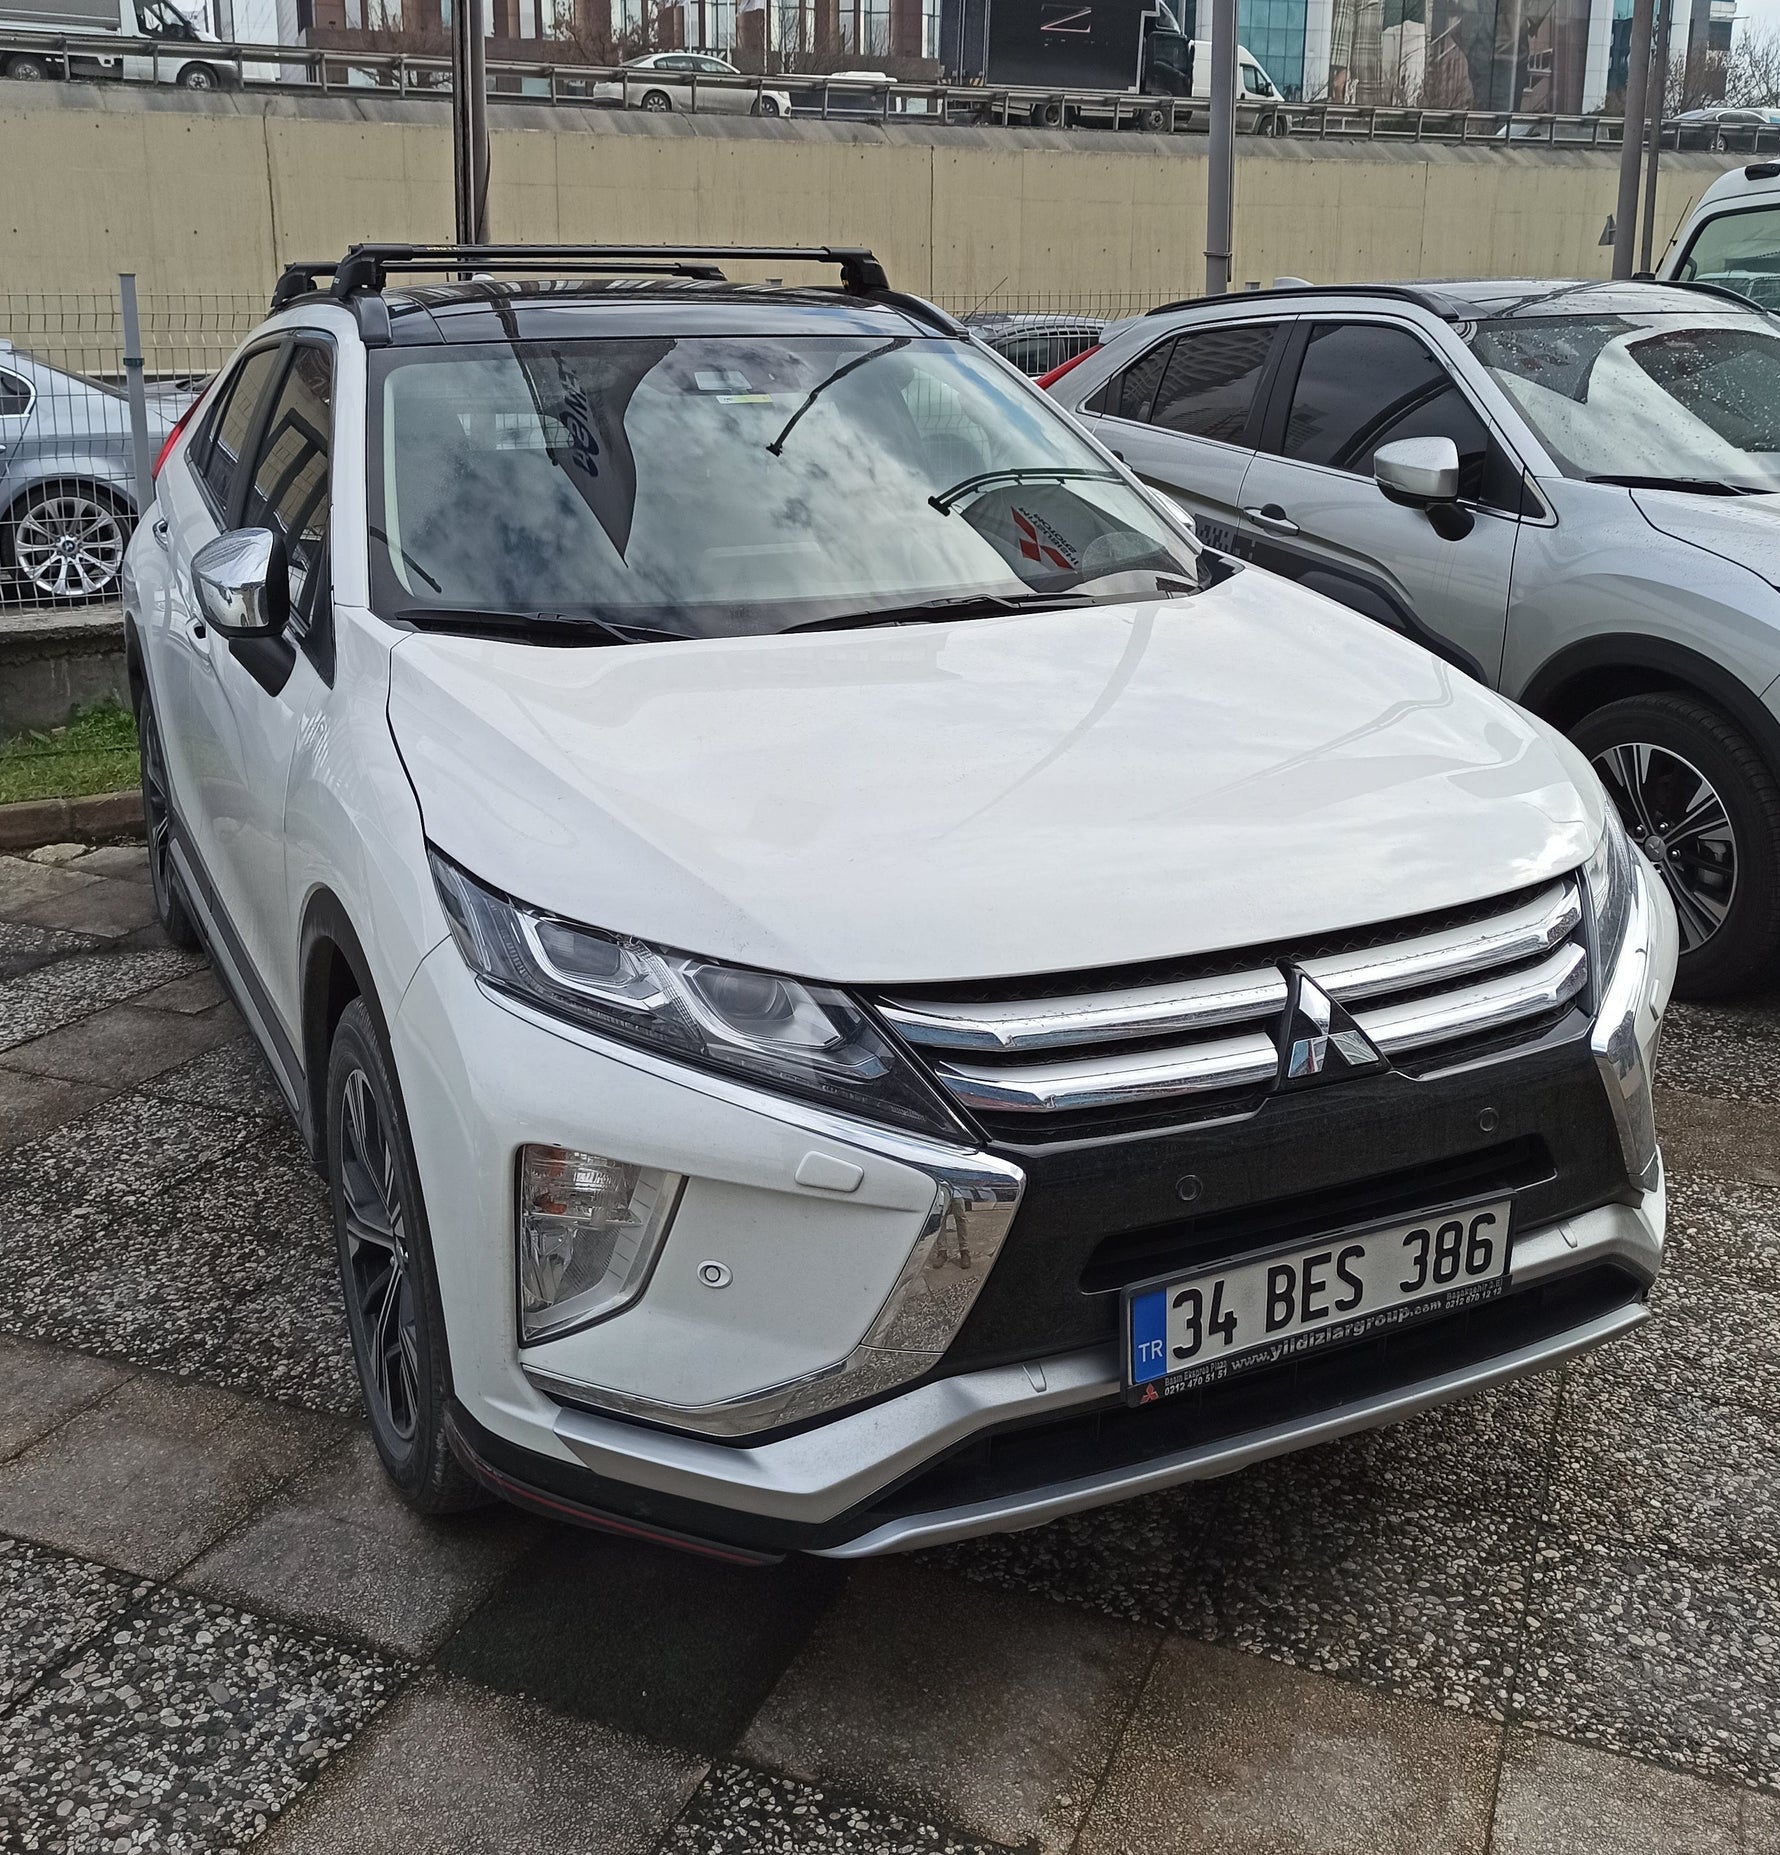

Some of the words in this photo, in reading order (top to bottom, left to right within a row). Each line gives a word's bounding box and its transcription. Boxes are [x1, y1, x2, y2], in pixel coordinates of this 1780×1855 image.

[1171, 1279, 1238, 1360] 34
[1265, 1244, 1366, 1333] BES
[1399, 1212, 1496, 1293] 386
[1445, 1296, 1465, 1309] 0212
[1138, 1338, 1164, 1363] TR
[1164, 1382, 1186, 1396] 0212
[1187, 1376, 1203, 1388] 470
[1205, 1372, 1215, 1382] 51
[1217, 1368, 1227, 1379] 51
